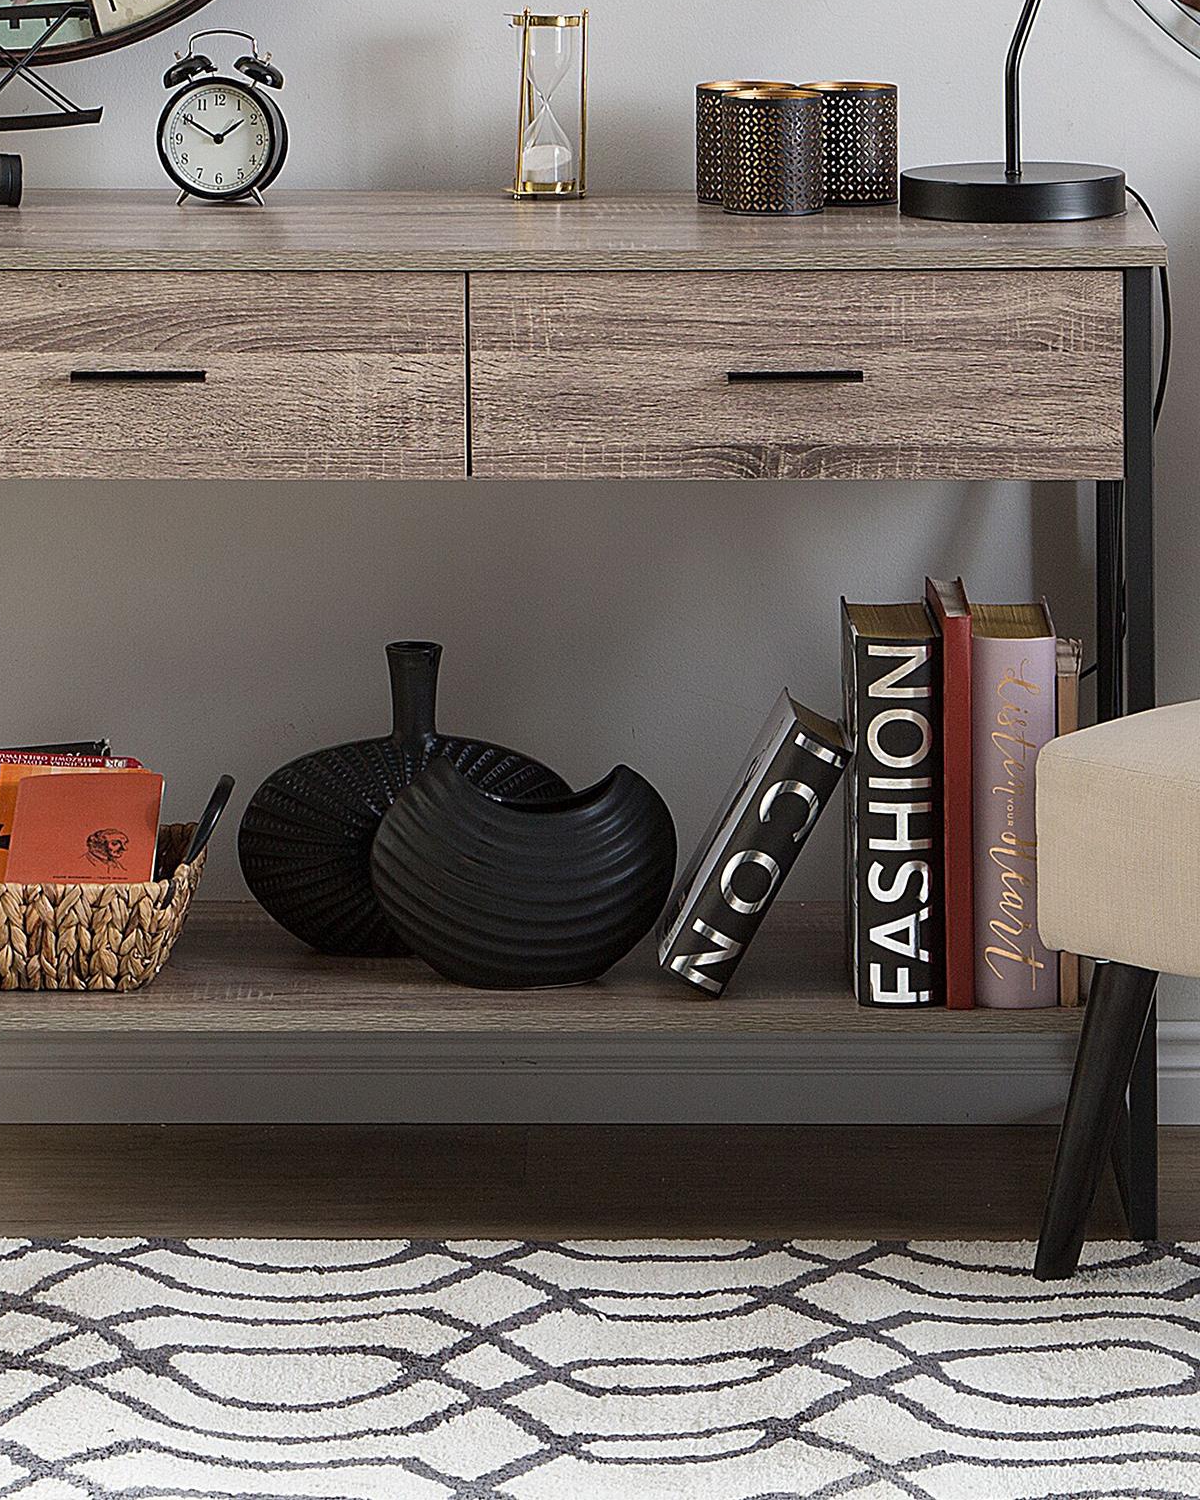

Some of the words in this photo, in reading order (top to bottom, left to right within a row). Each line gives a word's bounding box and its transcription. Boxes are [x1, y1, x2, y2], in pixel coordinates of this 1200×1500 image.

[197, 98, 207, 111] 11
[214, 93, 227, 106] 12
[236, 98, 242, 111] 1
[250, 114, 258, 126] 2
[175, 133, 183, 146] 9
[255, 134, 264, 146] 3
[180, 153, 189, 165] 8
[248, 154, 257, 166] 4
[196, 167, 204, 179] 7
[215, 172, 223, 185] 6
[237, 168, 245, 180] 5
[991, 658, 1041, 796] Listen
[1006, 797, 1016, 828] YOUR
[867, 644, 933, 1004] FASHION
[670, 732, 846, 996] ICON
[985, 831, 1045, 992] Heart
